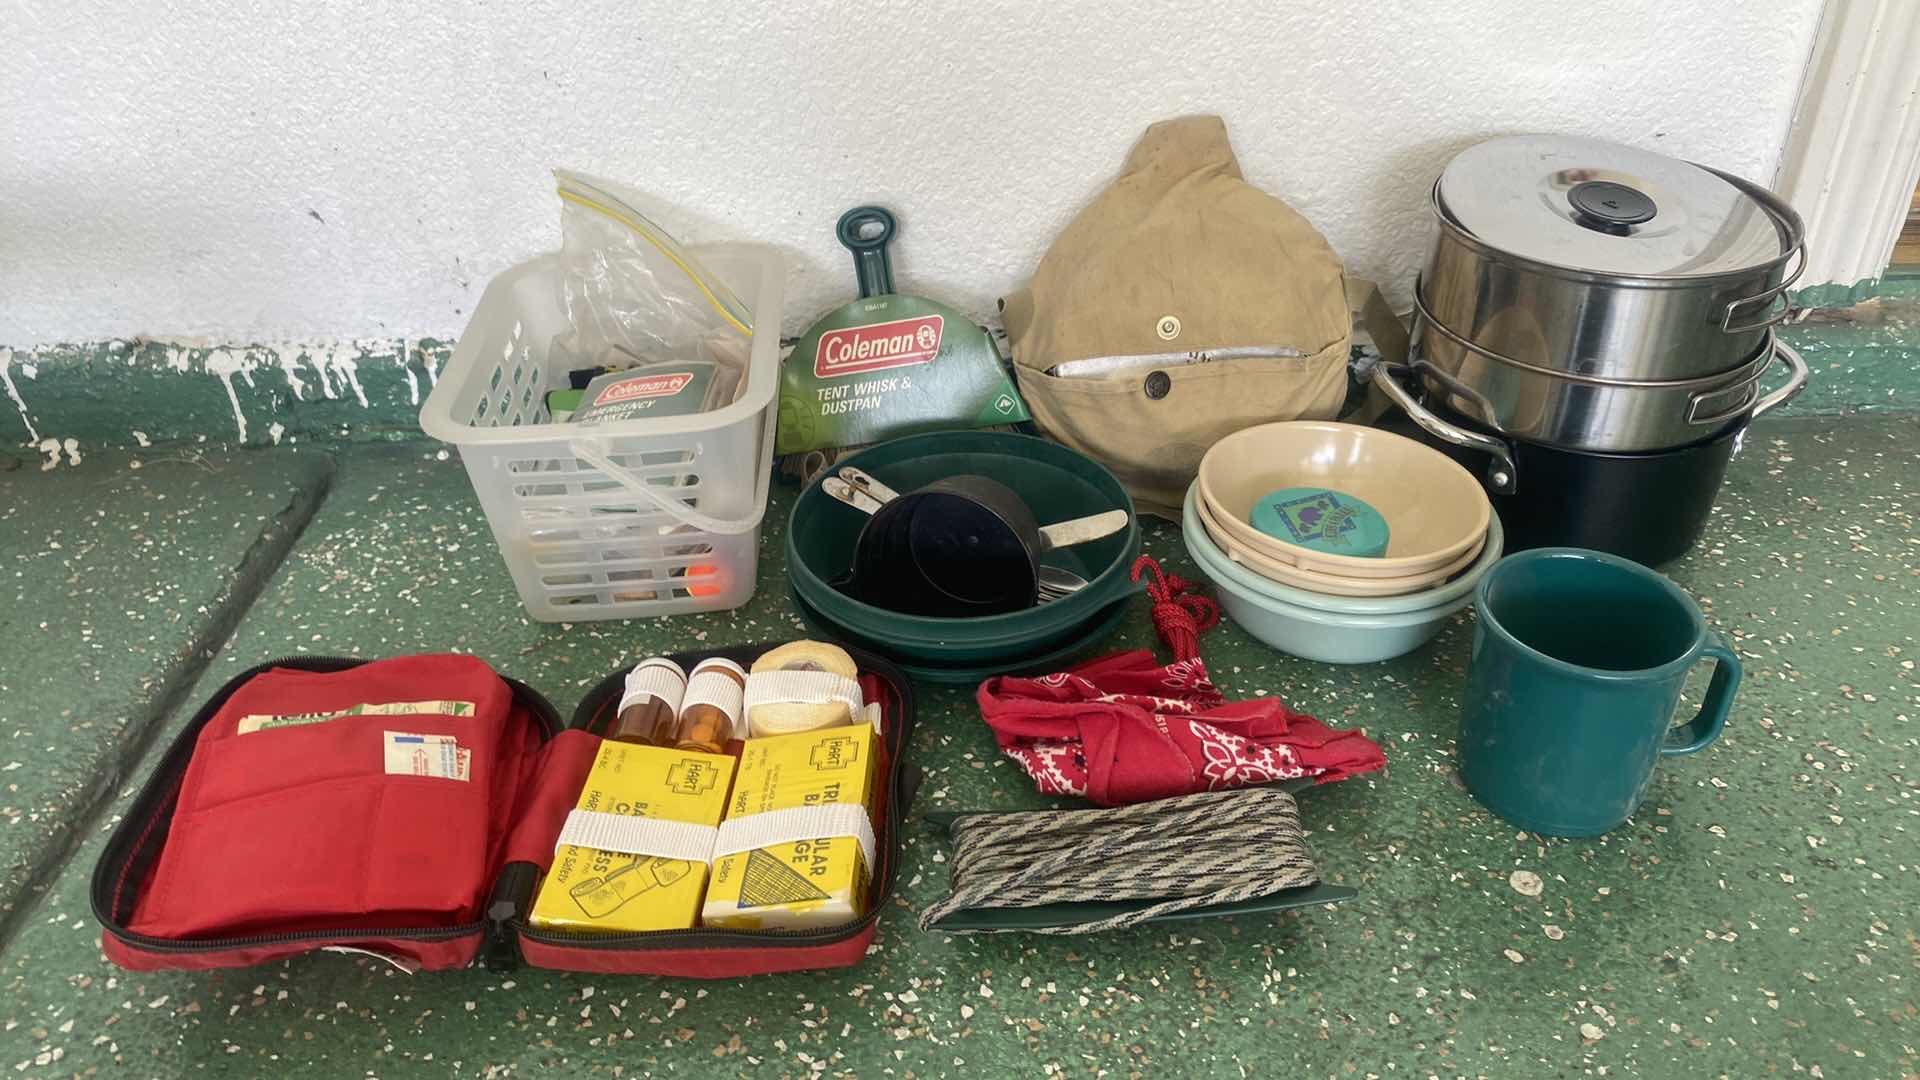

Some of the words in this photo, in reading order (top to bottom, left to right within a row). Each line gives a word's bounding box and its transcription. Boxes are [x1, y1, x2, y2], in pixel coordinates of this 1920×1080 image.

[825, 331, 915, 366] Coleman
[606, 379, 669, 399] Coleman
[817, 384, 850, 401] TENT
[854, 377, 898, 397] WHISK
[901, 375, 912, 390] &
[820, 394, 882, 416] DUSTPAN
[827, 740, 842, 766] HART
[683, 763, 702, 790] HART
[735, 790, 749, 814] HART
[558, 855, 577, 883] Safety
